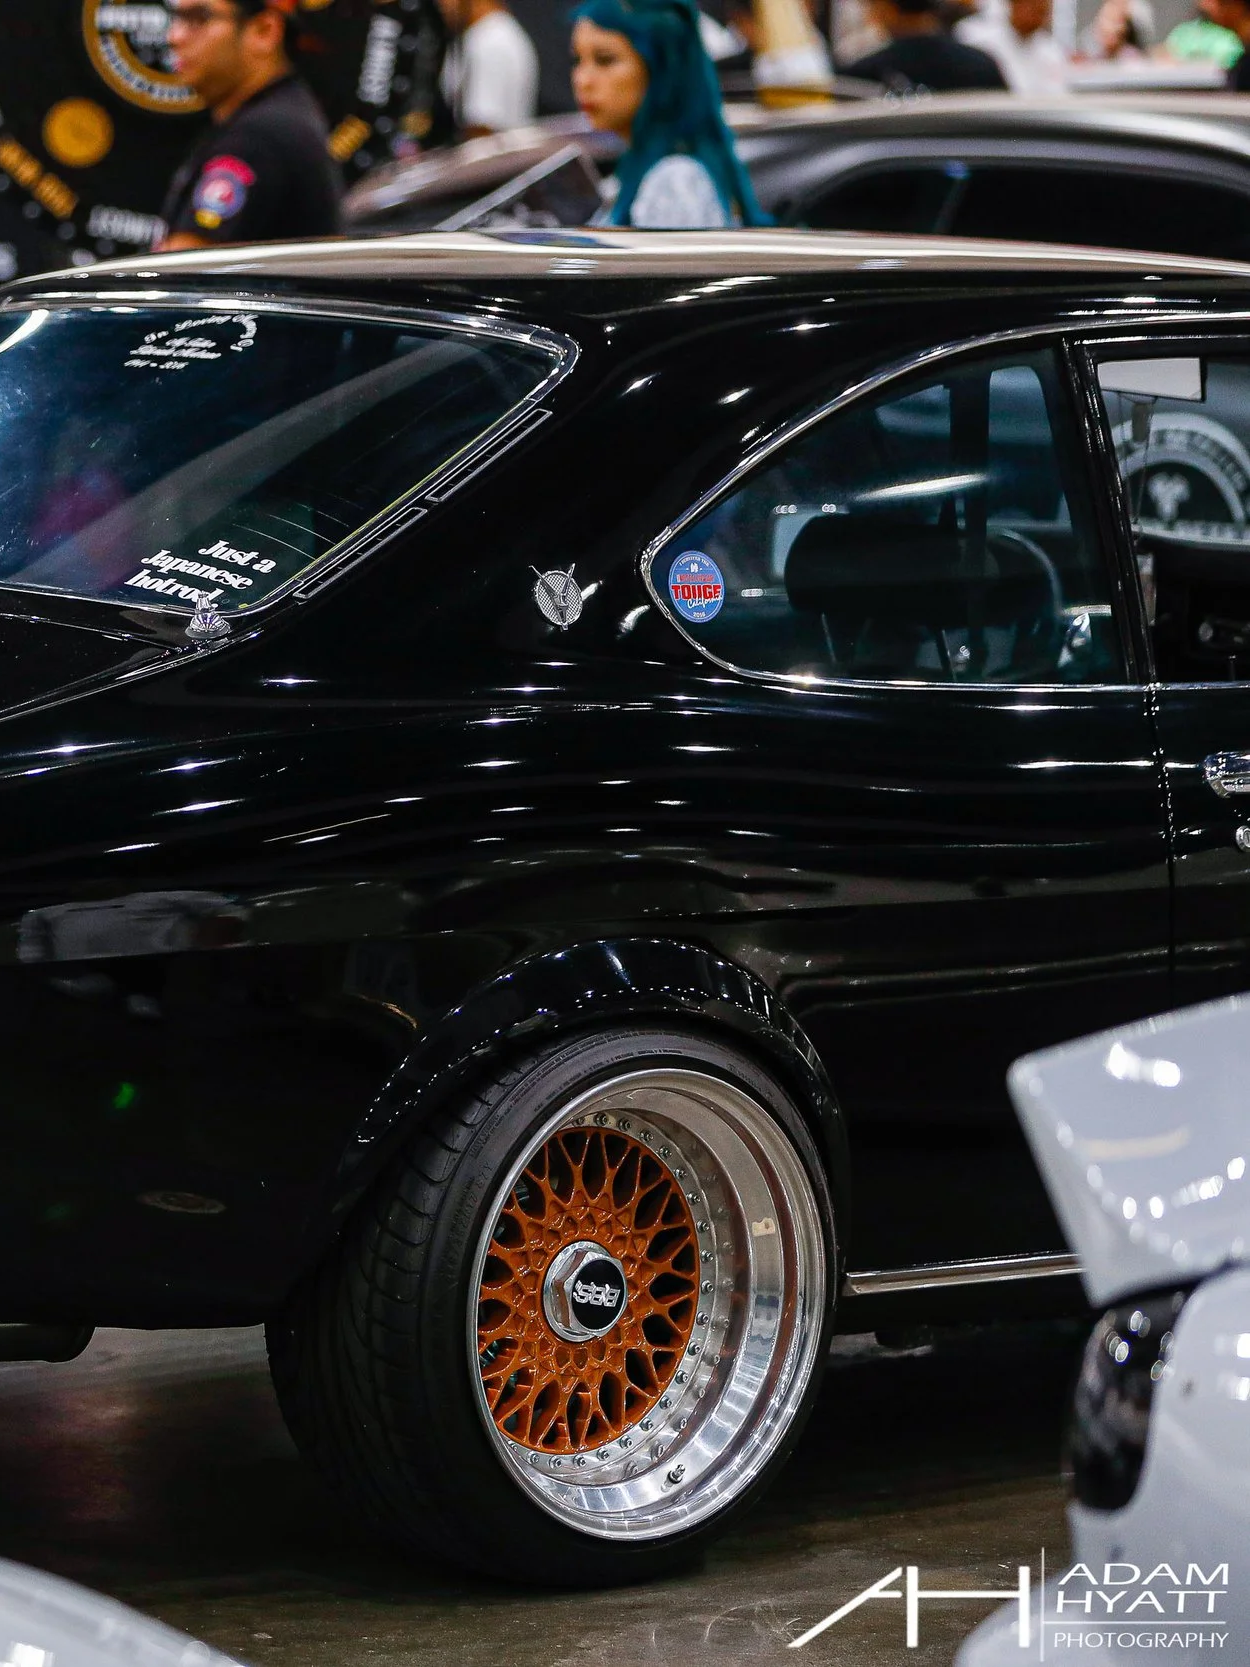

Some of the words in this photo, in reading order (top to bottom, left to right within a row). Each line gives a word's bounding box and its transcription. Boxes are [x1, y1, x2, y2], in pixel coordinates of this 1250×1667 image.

[141, 550, 253, 589] Japanese
[198, 540, 258, 566] Just
[252, 558, 277, 573] a
[671, 584, 722, 601] TOUGE
